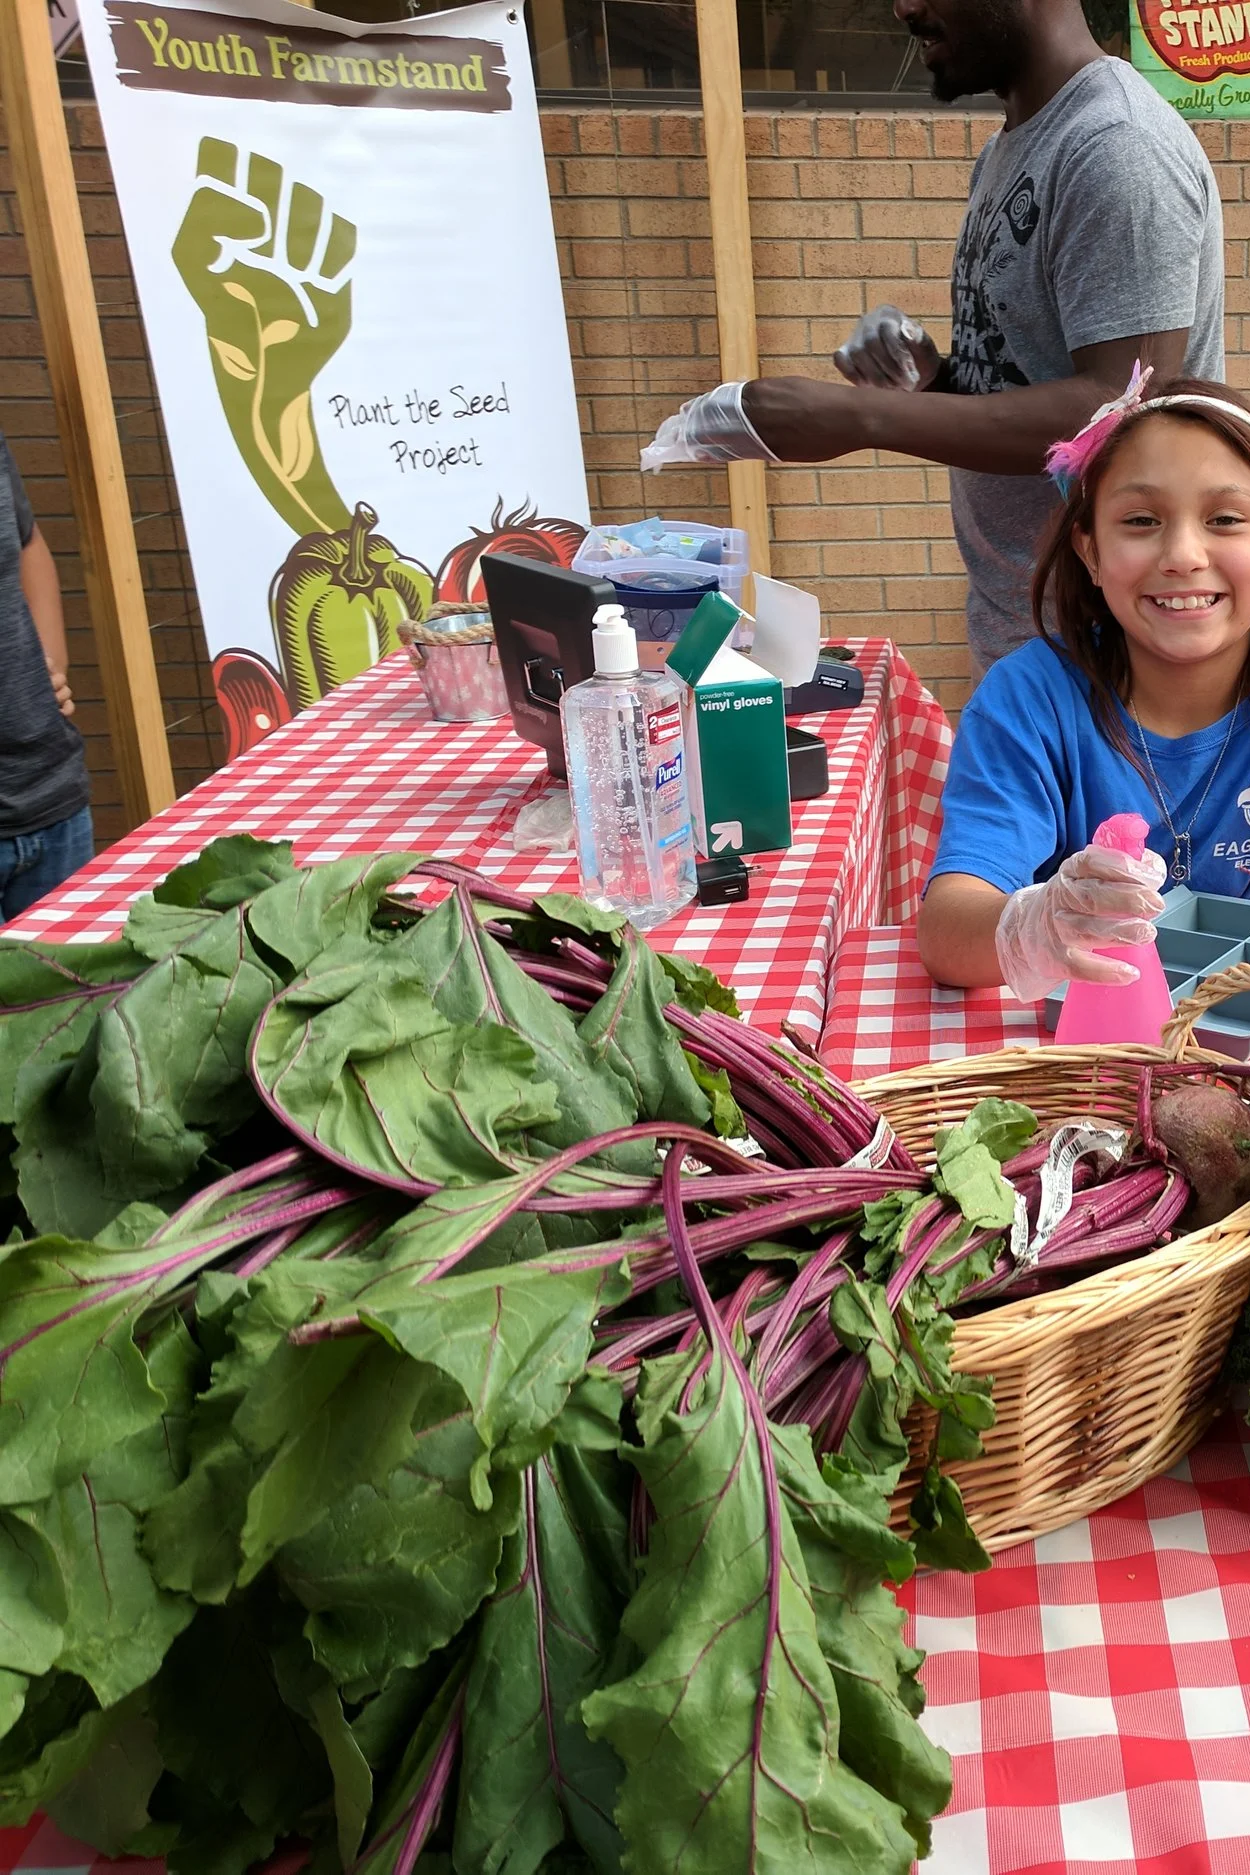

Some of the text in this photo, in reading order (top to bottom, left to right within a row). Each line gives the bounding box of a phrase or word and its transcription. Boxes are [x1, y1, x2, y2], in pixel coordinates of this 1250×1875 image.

[135, 18, 487, 92] Youth Farmstand
[1179, 54, 1211, 67] Fresh
[328, 381, 510, 429] Plant the Seed
[389, 437, 482, 475] Project
[700, 694, 774, 712] vinyl gloves
[658, 759, 681, 785] Purell
